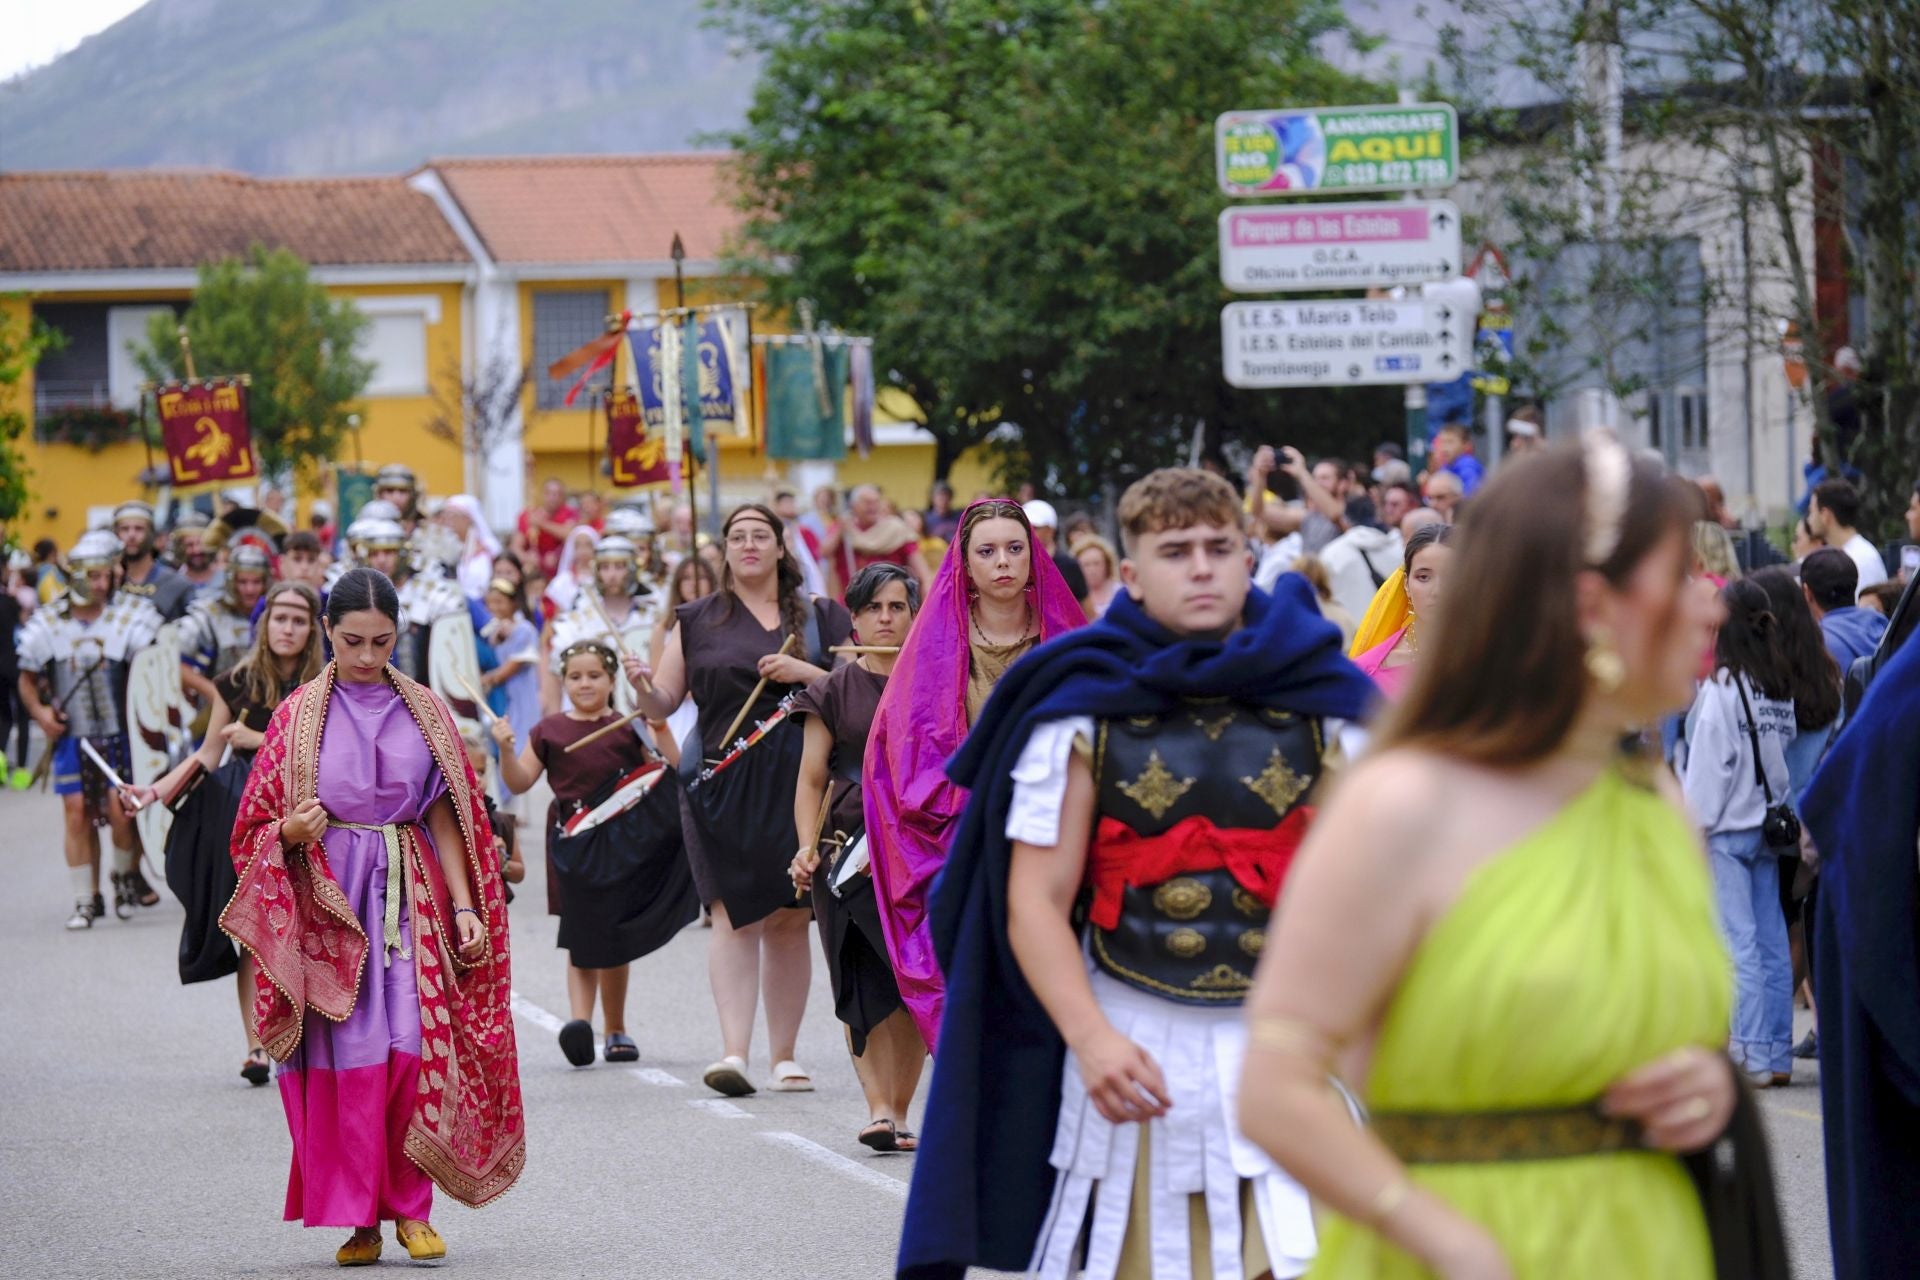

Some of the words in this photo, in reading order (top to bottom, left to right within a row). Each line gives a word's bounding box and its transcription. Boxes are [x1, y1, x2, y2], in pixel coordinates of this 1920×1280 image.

[1330, 131, 1442, 162] AQUÍ
[1229, 152, 1268, 167] NO
[1236, 218, 1290, 241] Parque
[1295, 219, 1313, 239] de
[1318, 217, 1341, 238] las
[1344, 214, 1400, 237] Estelas
[1244, 264, 1297, 280] Oficina
[1302, 262, 1371, 279] Comarcal
[1378, 259, 1431, 279] Agraria
[1238, 307, 1290, 329] I.E.S.
[1288, 332, 1344, 352] Estelas
[1351, 331, 1373, 349] del
[1242, 361, 1330, 379] Torrelavega
